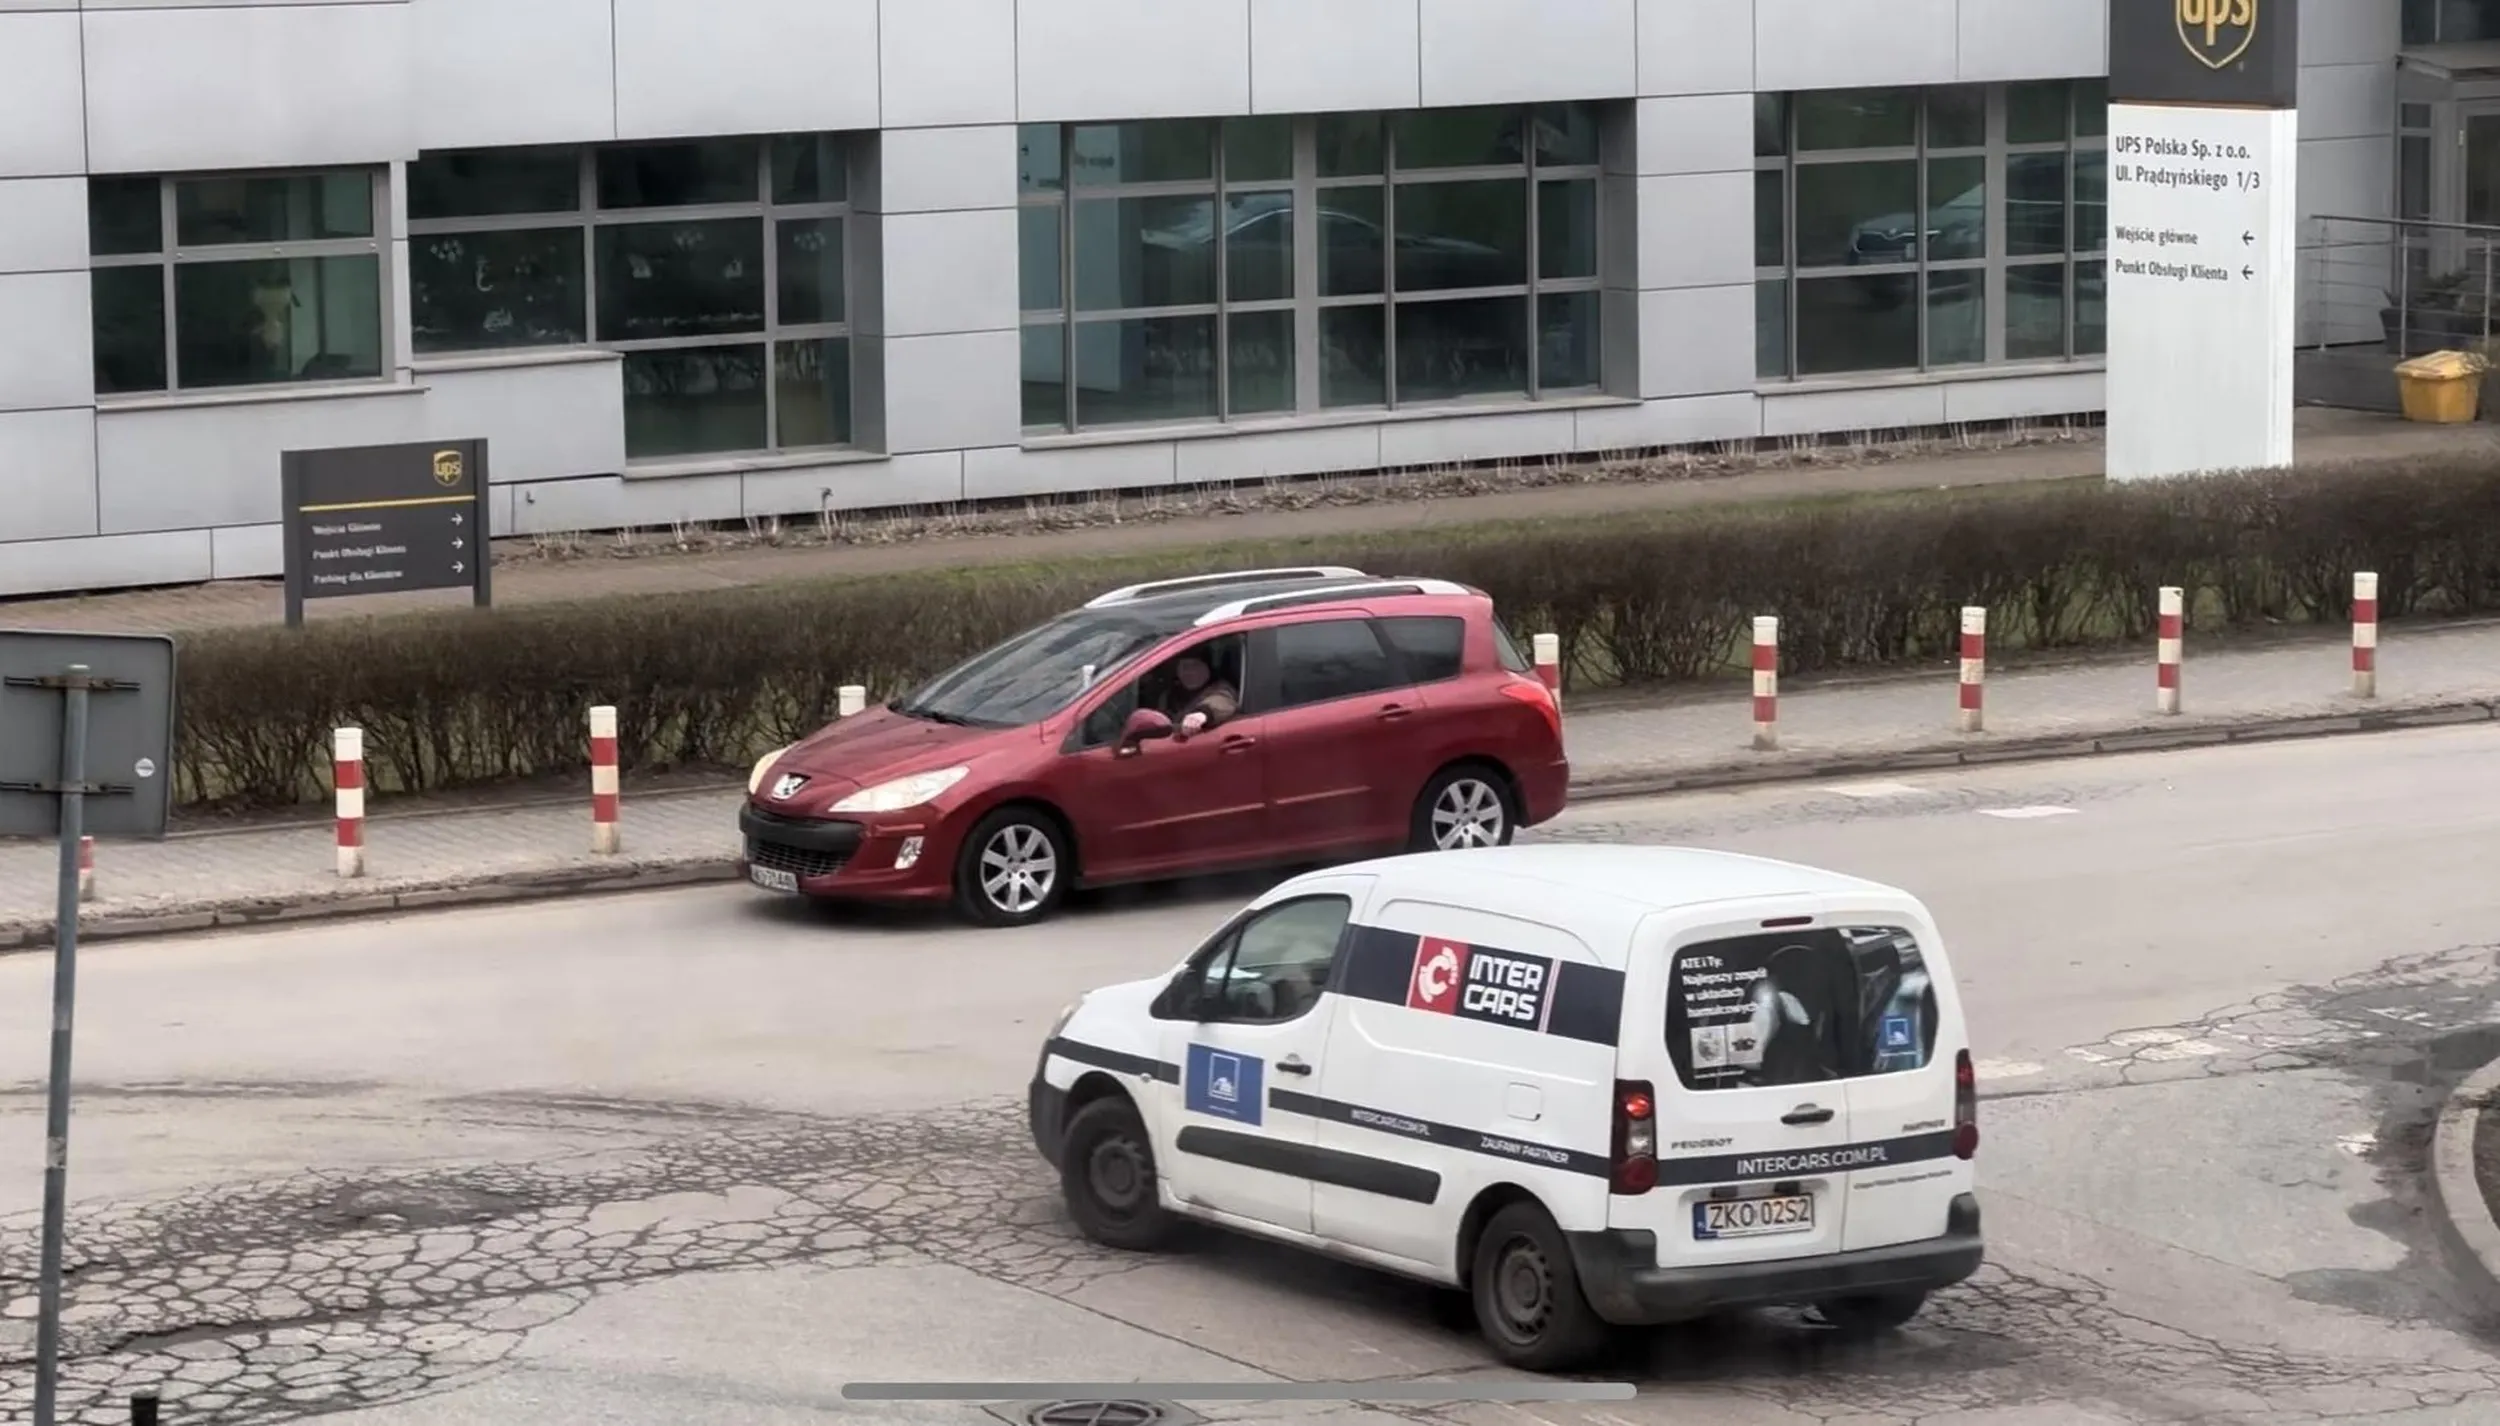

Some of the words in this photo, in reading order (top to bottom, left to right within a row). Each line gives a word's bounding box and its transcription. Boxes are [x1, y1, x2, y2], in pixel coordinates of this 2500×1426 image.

[2182, 0, 2250, 46] ups
[2115, 136, 2141, 154] UPS
[2145, 138, 2187, 157] Polska
[2192, 140, 2211, 160] Sp.
[2216, 144, 2222, 157] z
[2226, 144, 2250, 159] o.o.
[2115, 165, 2132, 182] Ul.
[2136, 166, 2228, 190] Prądzyńskiego
[2237, 171, 2260, 192] 1/3
[2115, 226, 2155, 243] Wejście
[2158, 230, 2198, 247] główne
[2115, 259, 2146, 275] Punkt
[2149, 262, 2188, 281] Obsługi
[2190, 264, 2228, 281] Klienta
[436, 462, 461, 481] ups
[1469, 953, 1543, 991] INTER
[1463, 984, 1537, 1021] CARS
[1351, 1109, 1431, 1136] INTERCARS.COM.PL
[1480, 1136, 1521, 1154] ZAUFANY
[1522, 1144, 1569, 1164] PARTNER
[1737, 1146, 1888, 1175] INTERCARS.COM.PL
[1709, 1203, 1754, 1229] ZKO
[1760, 1199, 1810, 1224] 02S2
